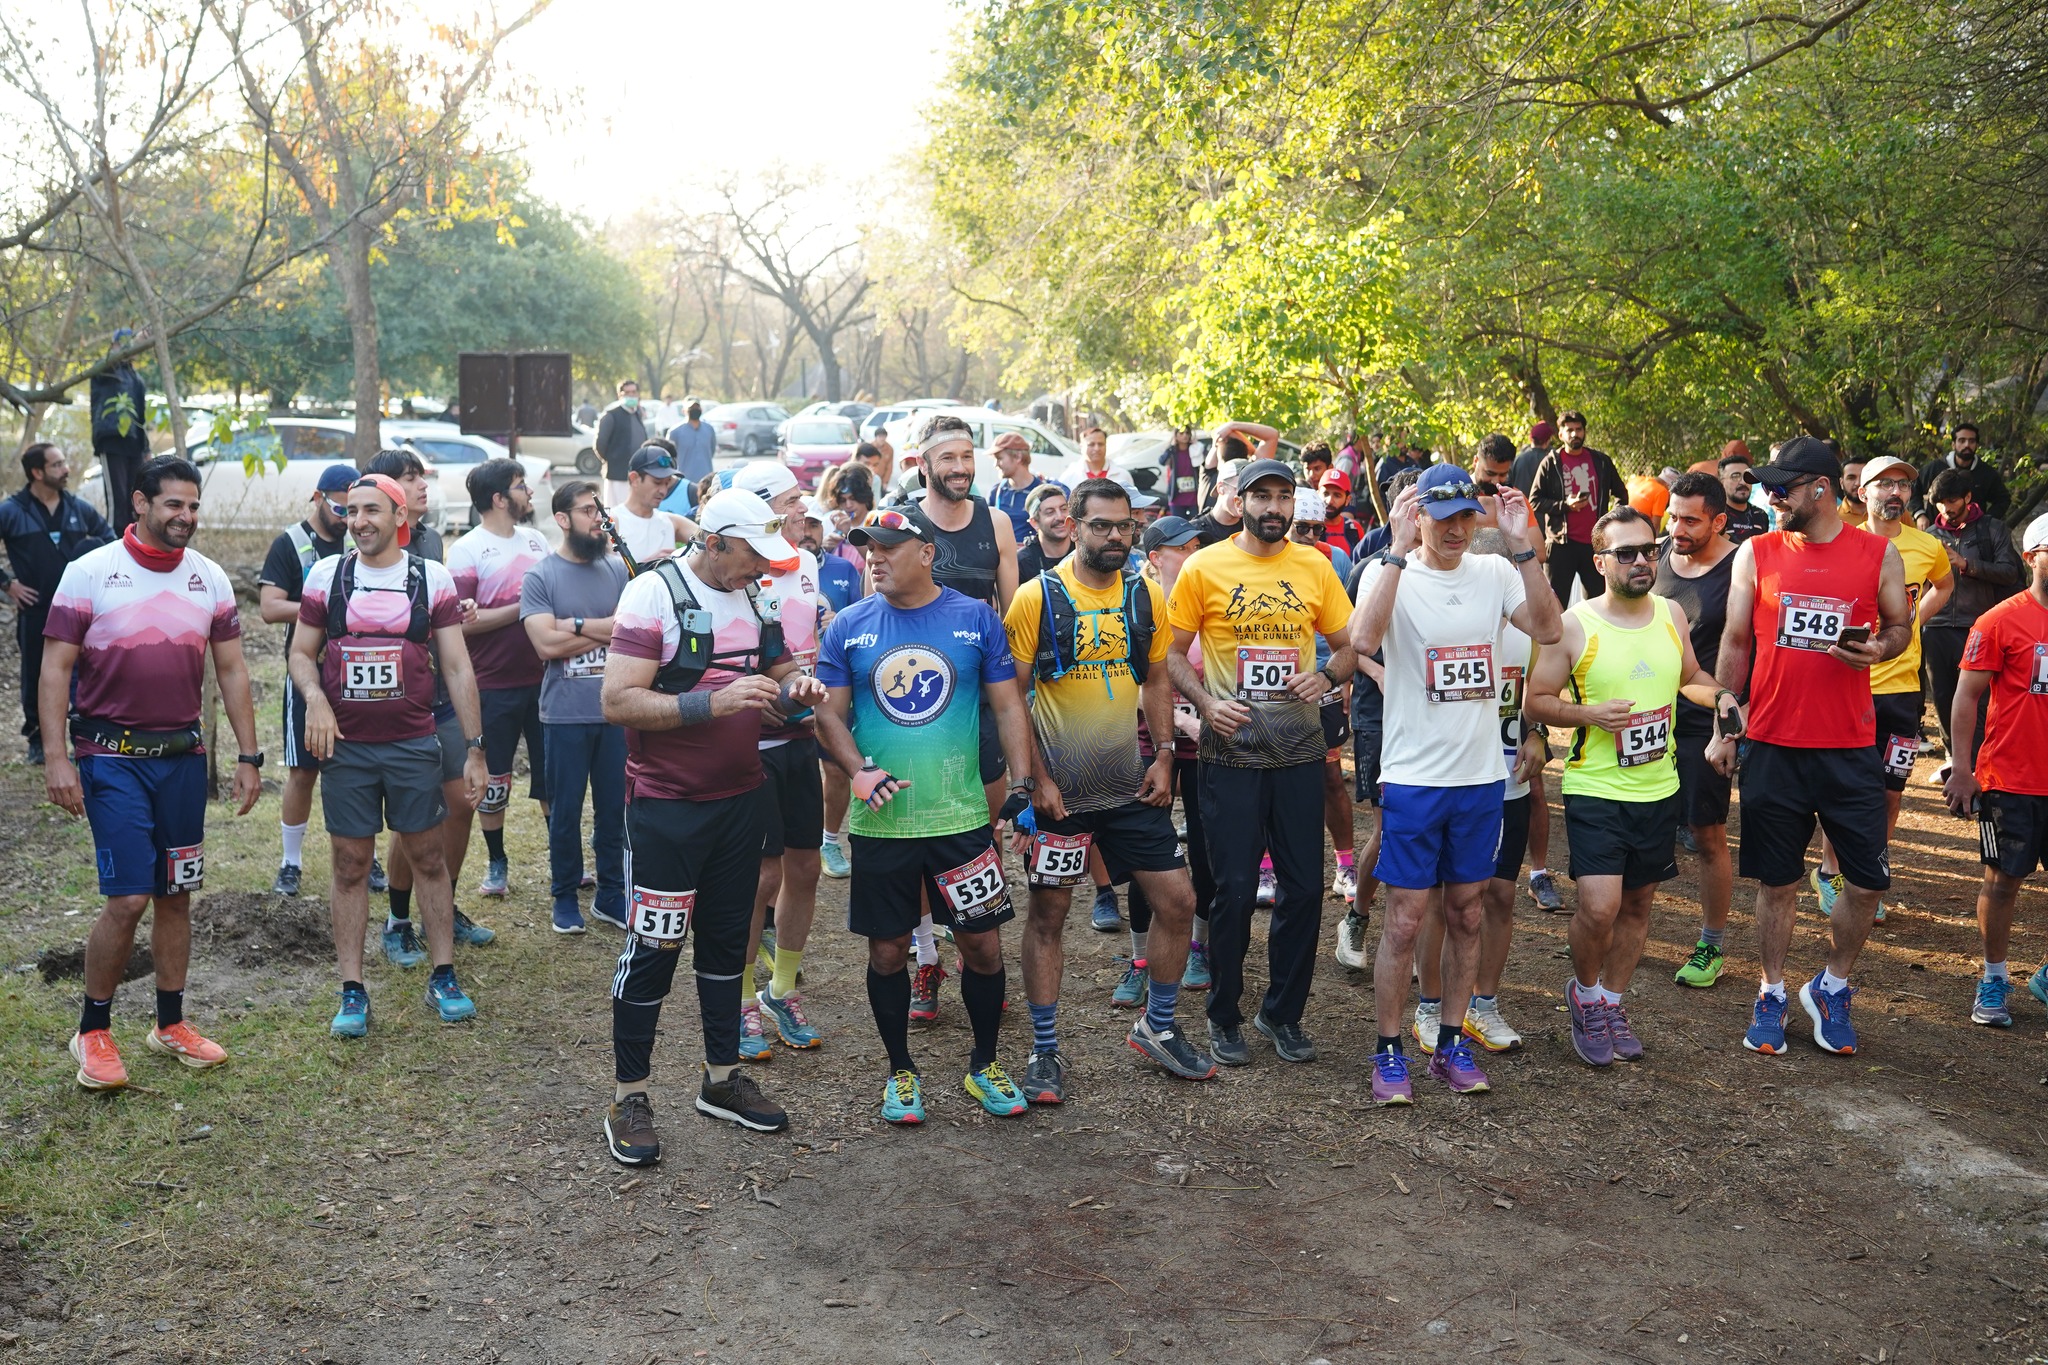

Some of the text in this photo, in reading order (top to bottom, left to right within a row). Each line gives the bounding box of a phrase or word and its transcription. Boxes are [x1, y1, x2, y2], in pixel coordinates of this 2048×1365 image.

[770, 601, 777, 610] G
[1810, 601, 1833, 610] MARATHON
[1233, 623, 1302, 633] MARGALLA
[1792, 611, 1839, 636] 548
[1263, 632, 1301, 640] RUNNERS
[353, 665, 392, 684] 515
[1443, 661, 1486, 685] 545
[1629, 671, 1656, 680] adidas
[1501, 682, 1512, 702] 6
[95, 732, 163, 756] naked
[1630, 722, 1667, 750] 544
[1045, 850, 1083, 872] 558
[956, 869, 1000, 905] 532
[642, 910, 686, 934] 513
